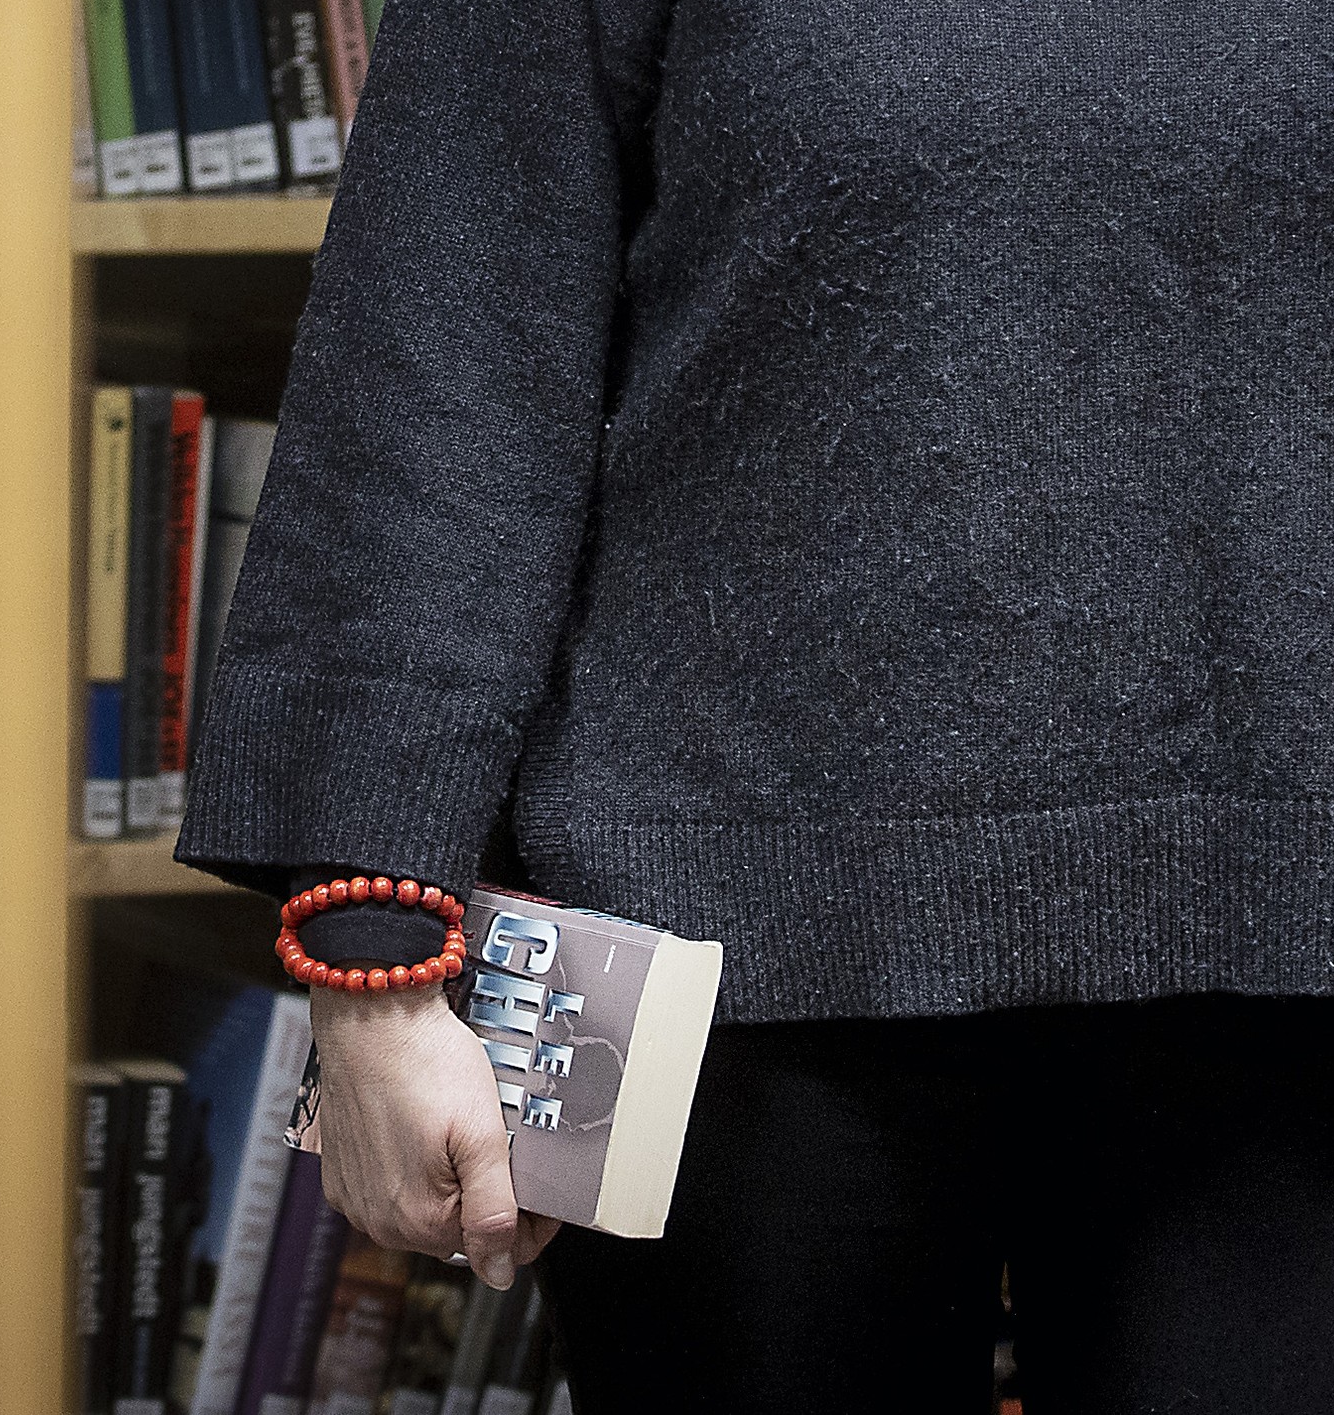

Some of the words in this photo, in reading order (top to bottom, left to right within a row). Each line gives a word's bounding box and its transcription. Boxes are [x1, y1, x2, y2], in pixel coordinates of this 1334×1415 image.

[144, 1086, 173, 1161] mari
[521, 988, 586, 1132] LEE
[130, 1169, 167, 1320] jungstedt
